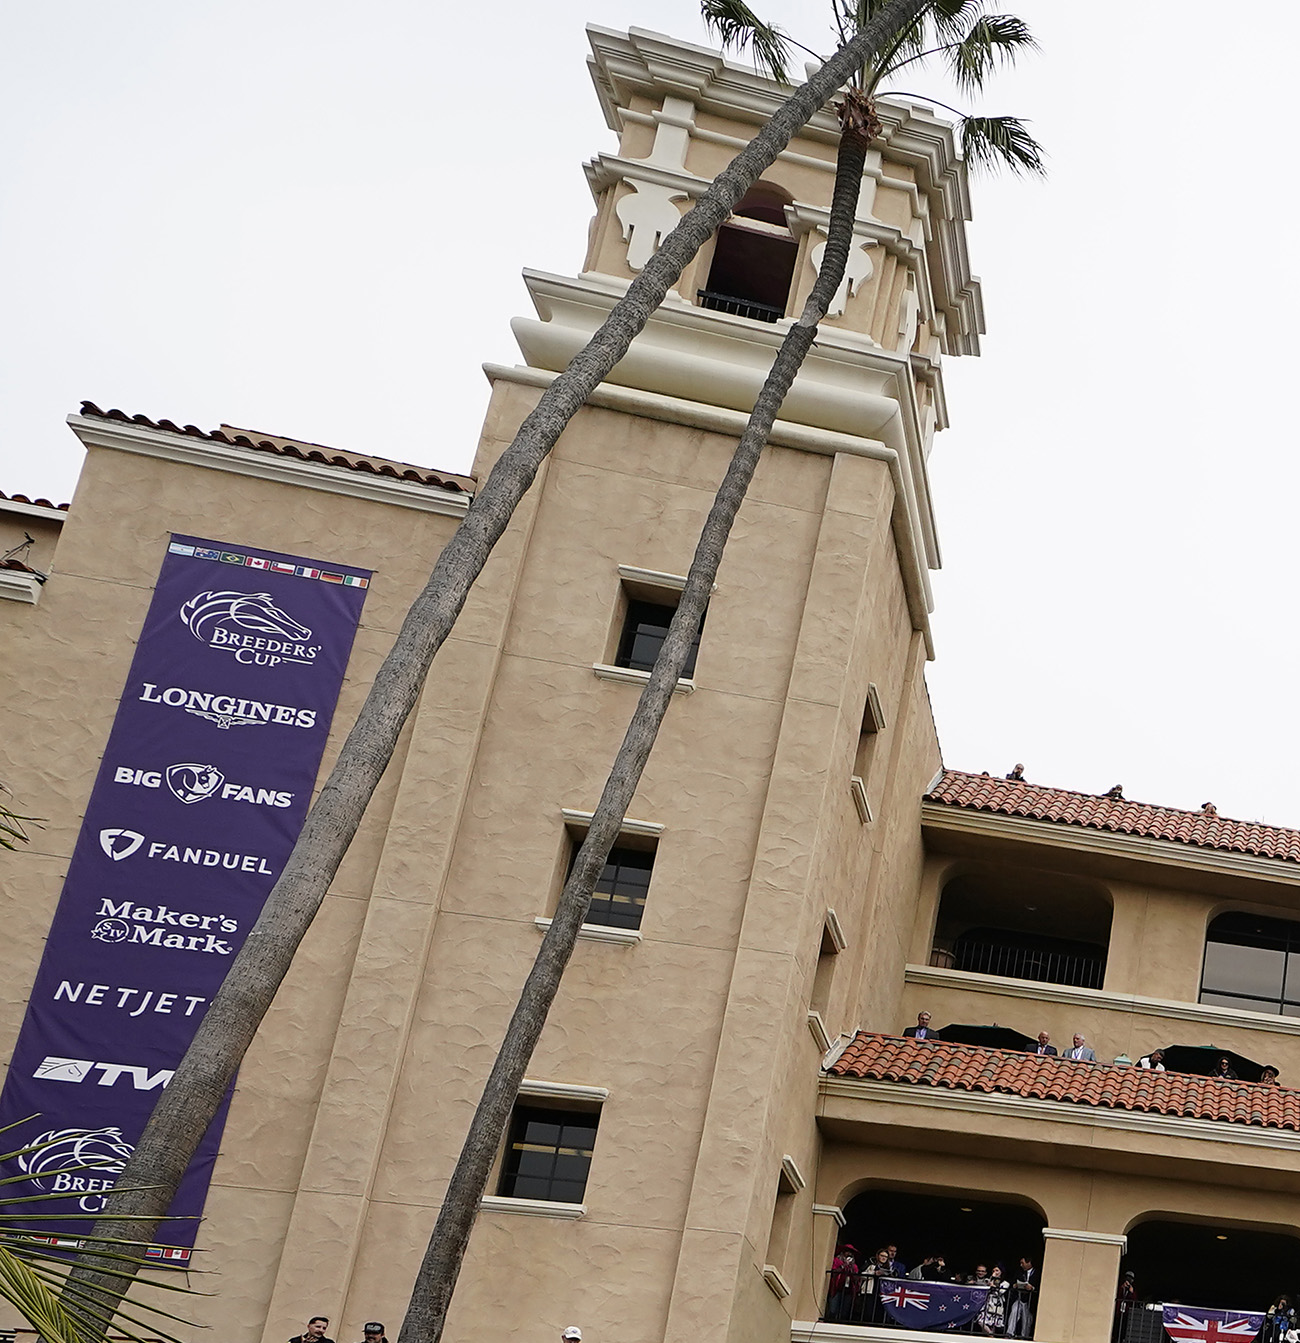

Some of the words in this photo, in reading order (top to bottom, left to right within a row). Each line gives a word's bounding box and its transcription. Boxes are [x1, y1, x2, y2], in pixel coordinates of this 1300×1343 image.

[210, 627, 322, 660] BREEDERS'
[235, 647, 282, 667] CUP
[139, 683, 317, 729] LONGINES
[114, 766, 161, 788] BIG
[221, 783, 292, 808] FANS
[148, 843, 273, 875] FANDUEL
[95, 898, 238, 933] Maker's
[127, 926, 229, 955] Mark
[53, 981, 213, 1017] NETJET
[95, 1061, 175, 1091] TV
